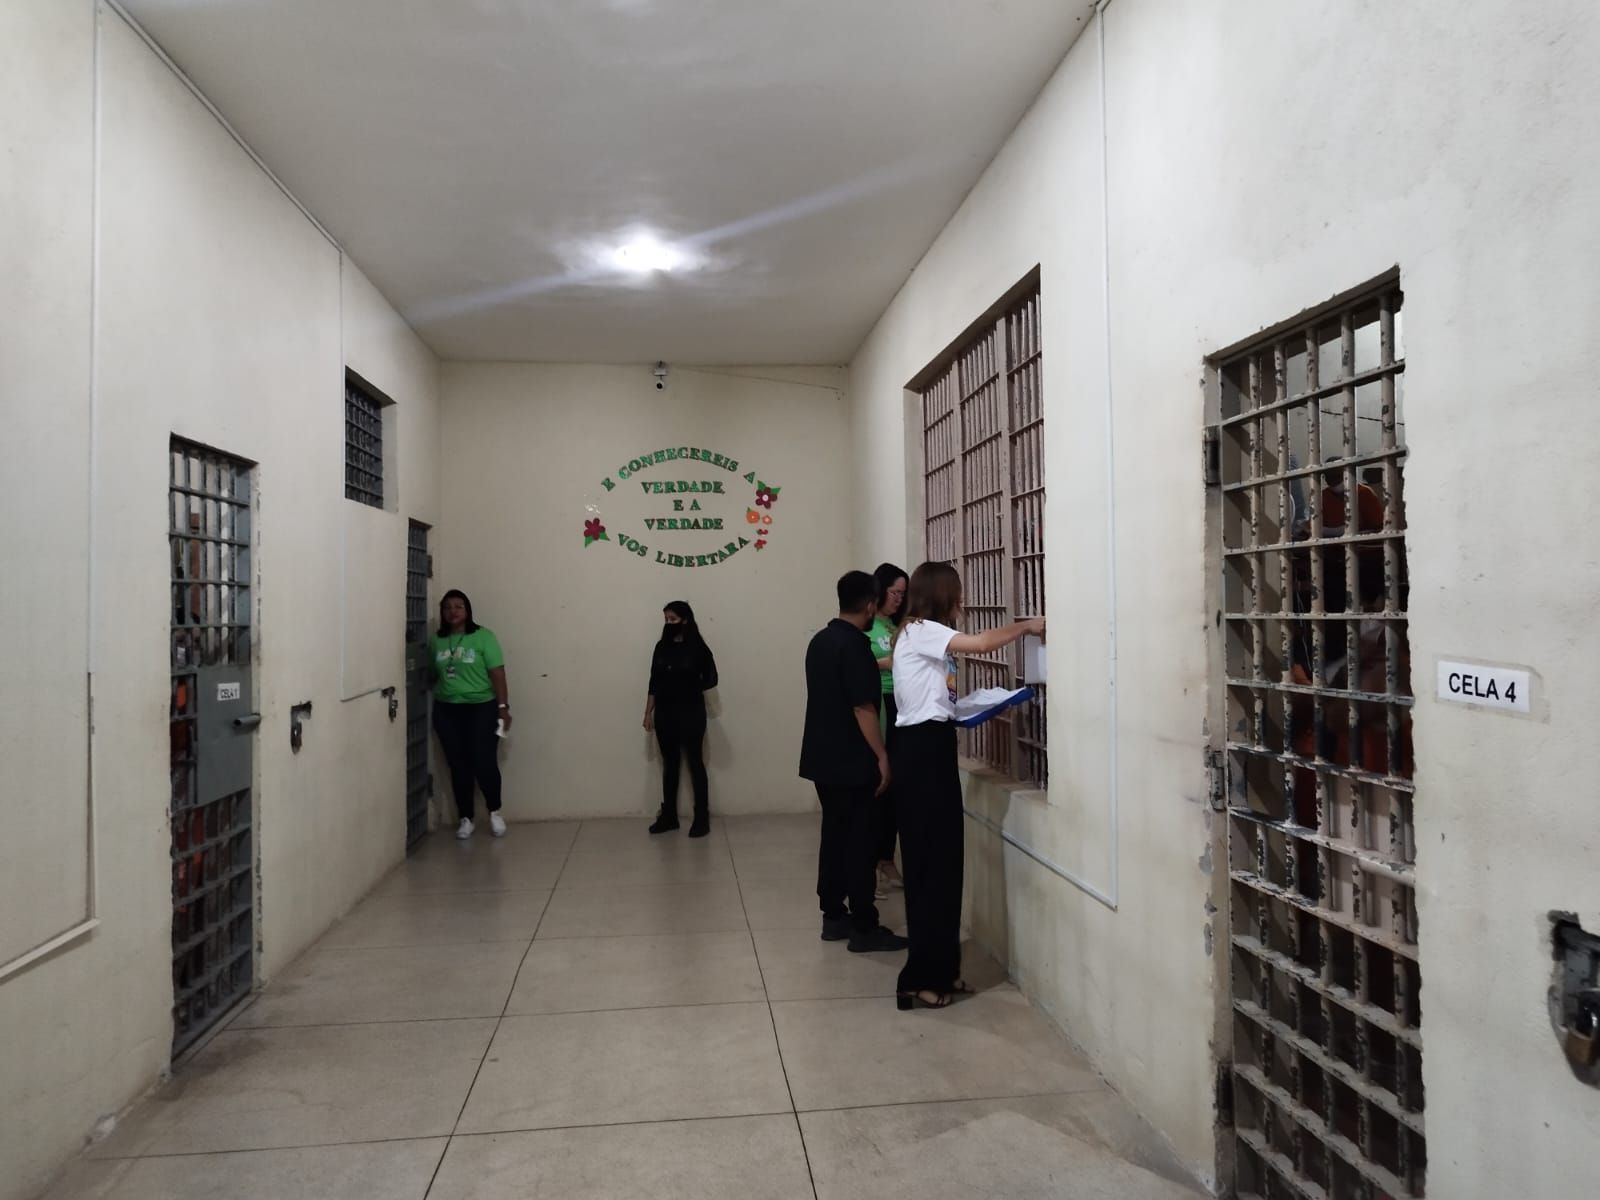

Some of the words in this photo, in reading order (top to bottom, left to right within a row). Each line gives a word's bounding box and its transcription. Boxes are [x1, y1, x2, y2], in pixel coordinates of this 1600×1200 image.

[601, 477, 616, 492] E
[618, 447, 739, 480] CONHECEREIS
[743, 471, 756, 484] A
[673, 499, 684, 511] E
[690, 499, 701, 511] A
[644, 518, 724, 530] VERDADE
[618, 533, 648, 557] VOS
[655, 536, 750, 567] LIBERTARA
[1448, 672, 1500, 701] CELA
[1504, 681, 1516, 703] 4
